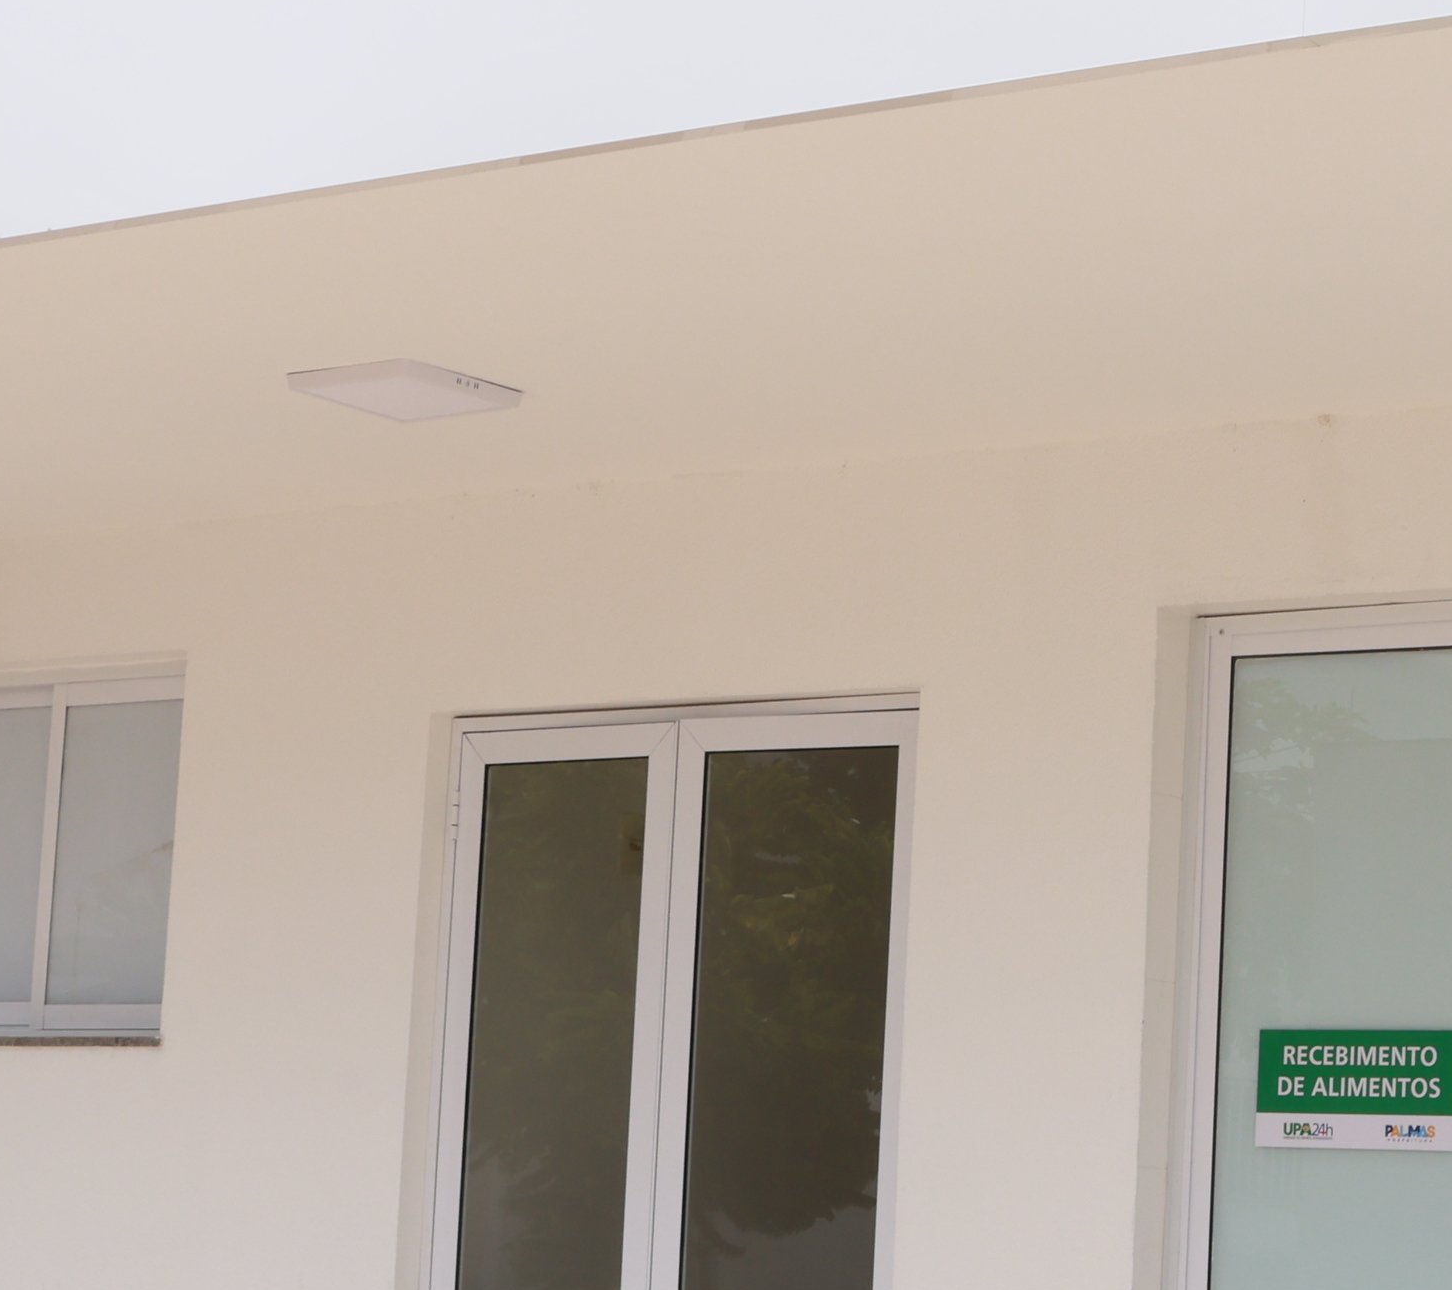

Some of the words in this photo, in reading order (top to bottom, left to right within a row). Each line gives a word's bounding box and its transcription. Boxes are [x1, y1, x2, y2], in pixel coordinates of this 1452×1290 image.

[1283, 1046, 1438, 1066] RECEBIMENTO
[1277, 1076, 1304, 1096] DE
[1311, 1077, 1441, 1098] ALIMENTOS
[1385, 1125, 1435, 1138] PALMAS
